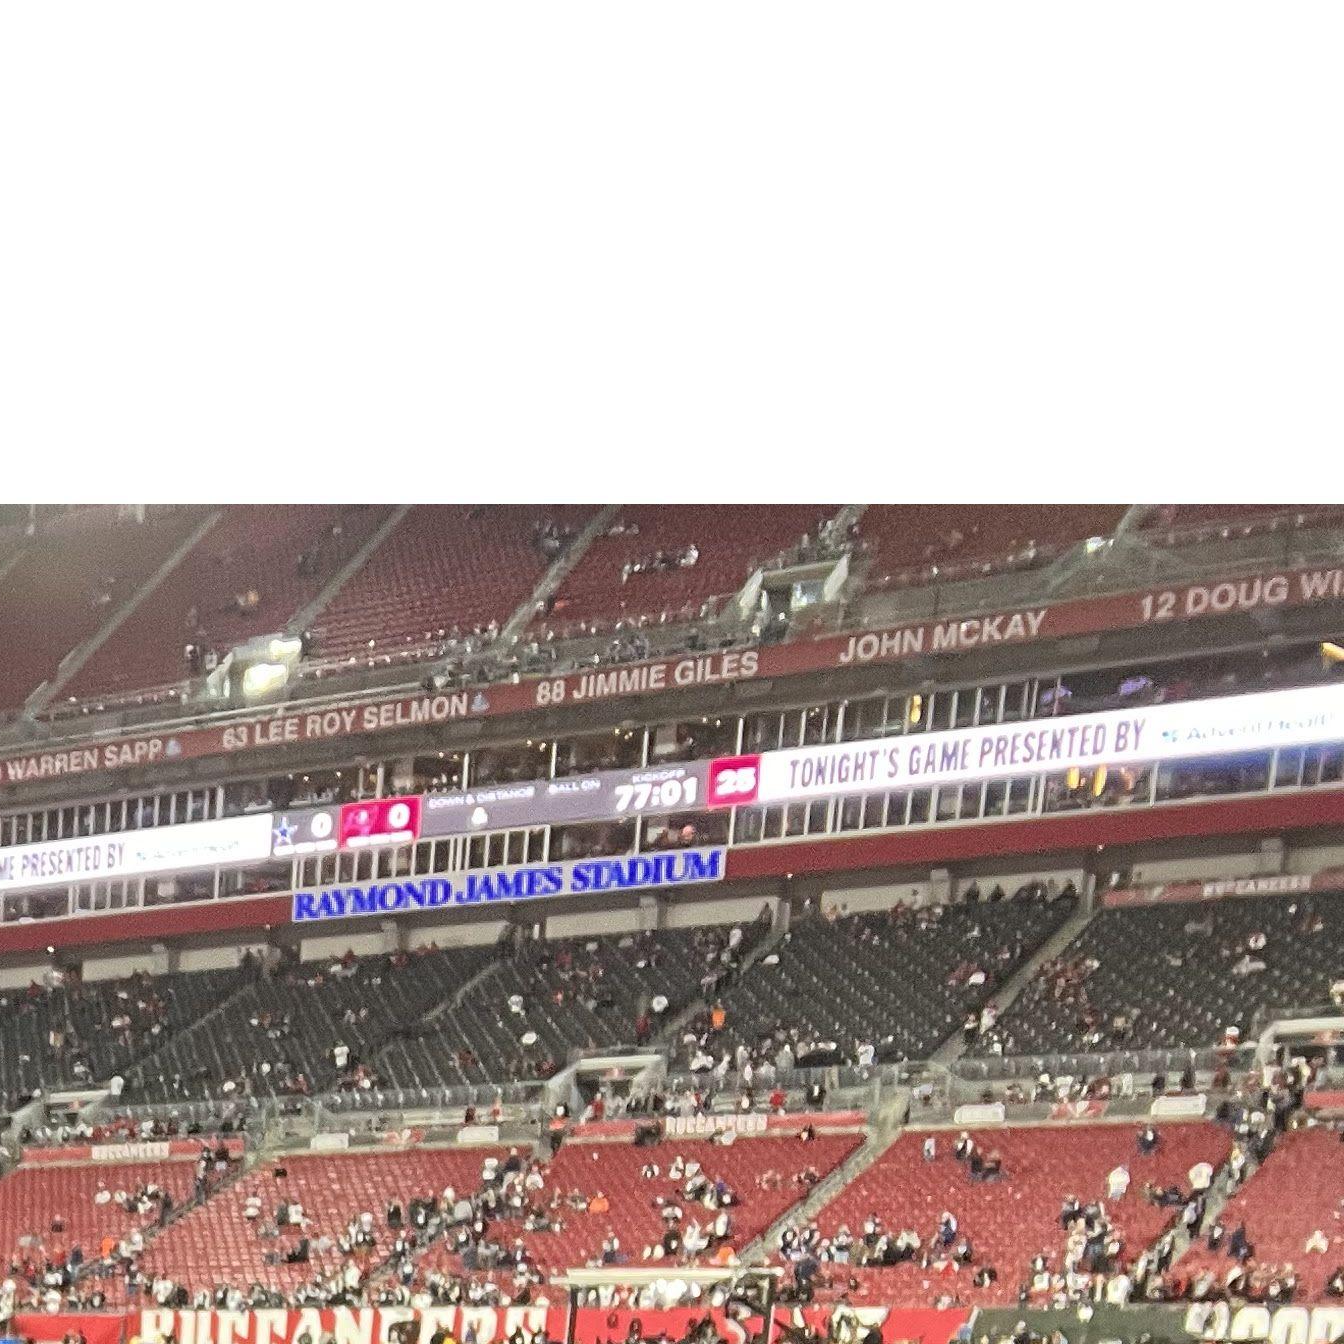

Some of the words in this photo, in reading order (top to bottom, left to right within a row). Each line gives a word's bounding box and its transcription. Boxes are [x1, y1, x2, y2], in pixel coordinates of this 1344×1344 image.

[1142, 592, 1177, 620] 12
[1185, 575, 1289, 617] DOUG
[1300, 569, 1344, 600] WI
[838, 628, 925, 665] JOHN
[933, 610, 1049, 652] MCKAY
[537, 679, 565, 704] 88
[572, 664, 667, 700] JIMMIE
[674, 650, 759, 685] GILES
[254, 715, 299, 745] LEE
[306, 705, 356, 737] ROY
[363, 693, 469, 731] SELMON
[7, 748, 99, 780] WARREN
[104, 739, 163, 767] SAPP
[789, 749, 900, 788] TONIGHT'S
[908, 741, 974, 777] GAME
[978, 725, 1108, 767] PRESENTED
[1114, 719, 1147, 752] BY
[615, 777, 699, 812] 77:01
[716, 769, 756, 796] 25
[310, 811, 333, 839] 0
[388, 803, 410, 829] 0
[20, 848, 101, 879] PRESENTED
[107, 842, 126, 868] BY
[293, 876, 452, 922] RAYMOND
[451, 866, 564, 905] JAMES
[570, 848, 722, 893] STADIUM
